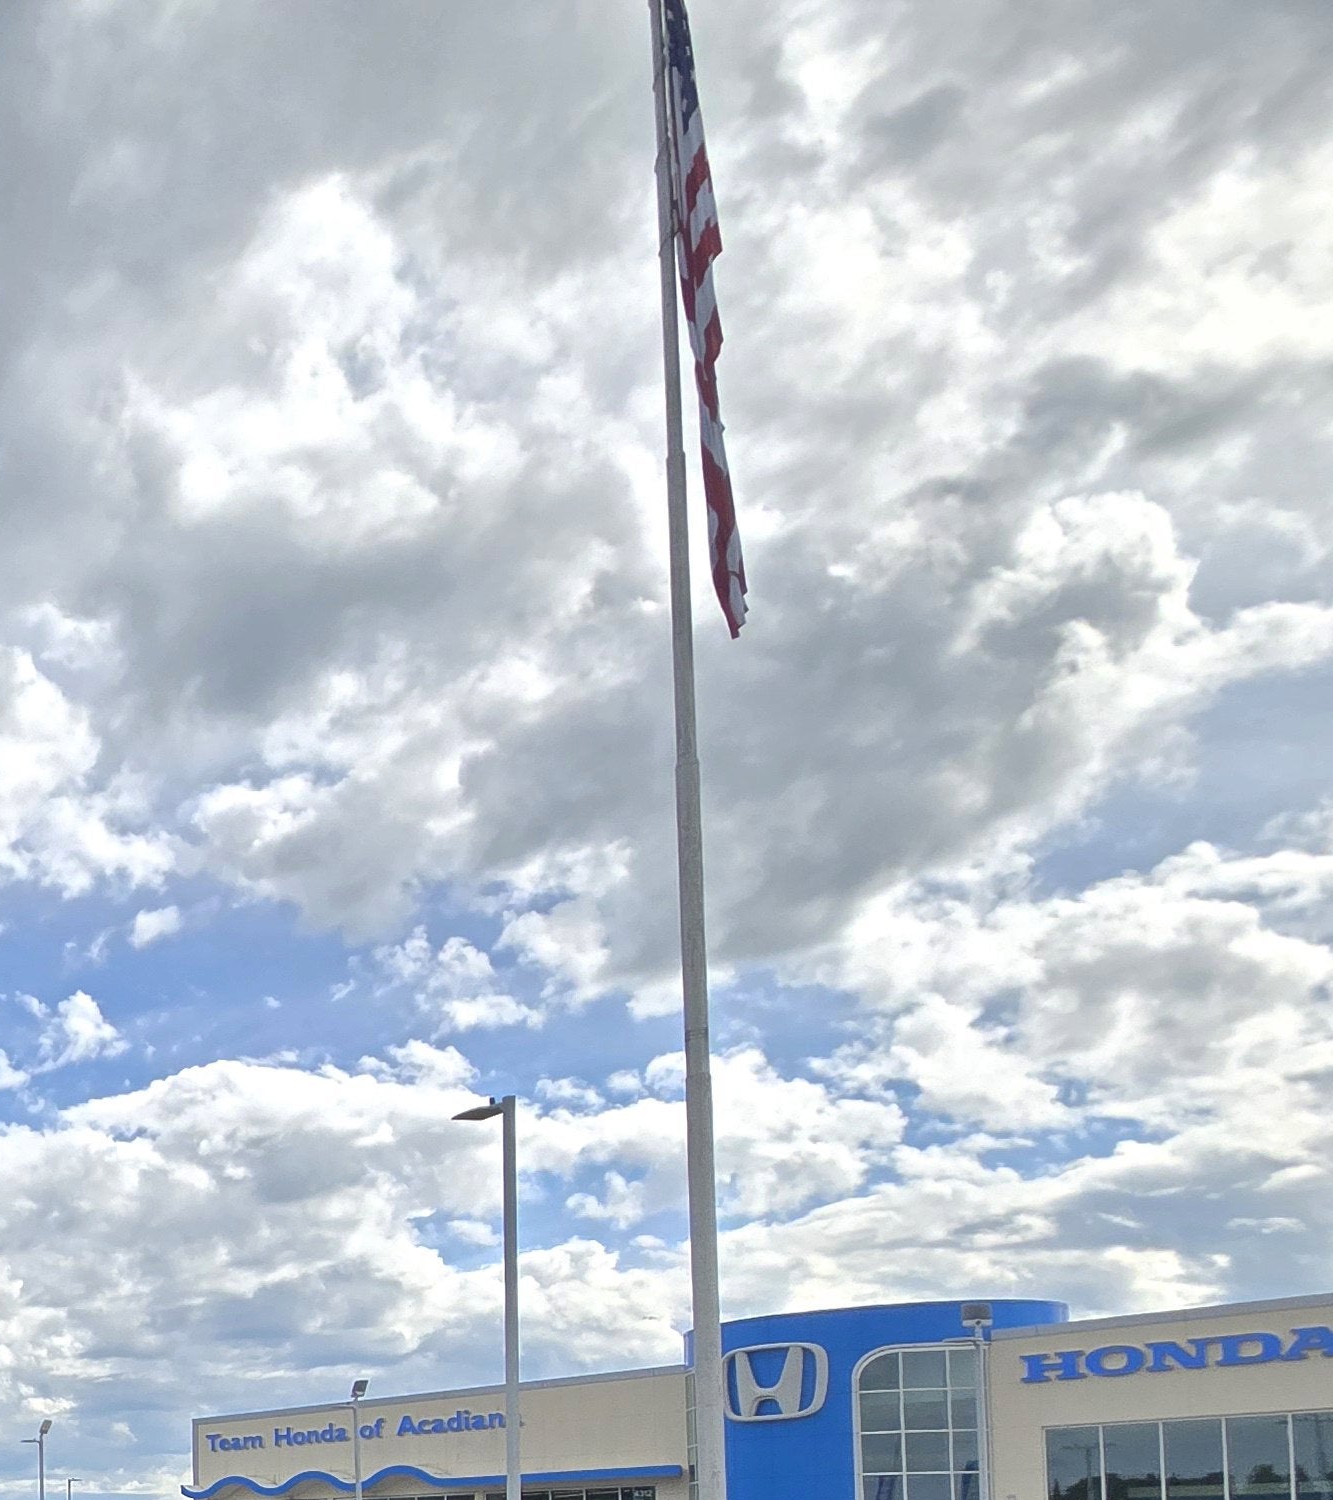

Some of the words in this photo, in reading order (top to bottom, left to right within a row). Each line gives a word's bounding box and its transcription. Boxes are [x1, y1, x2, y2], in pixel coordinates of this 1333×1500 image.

[1020, 1326, 1333, 1384] HONDA
[206, 1434, 264, 1453] Team
[274, 1422, 350, 1447] Honda
[360, 1417, 385, 1439] of
[397, 1409, 507, 1437] Acadian
